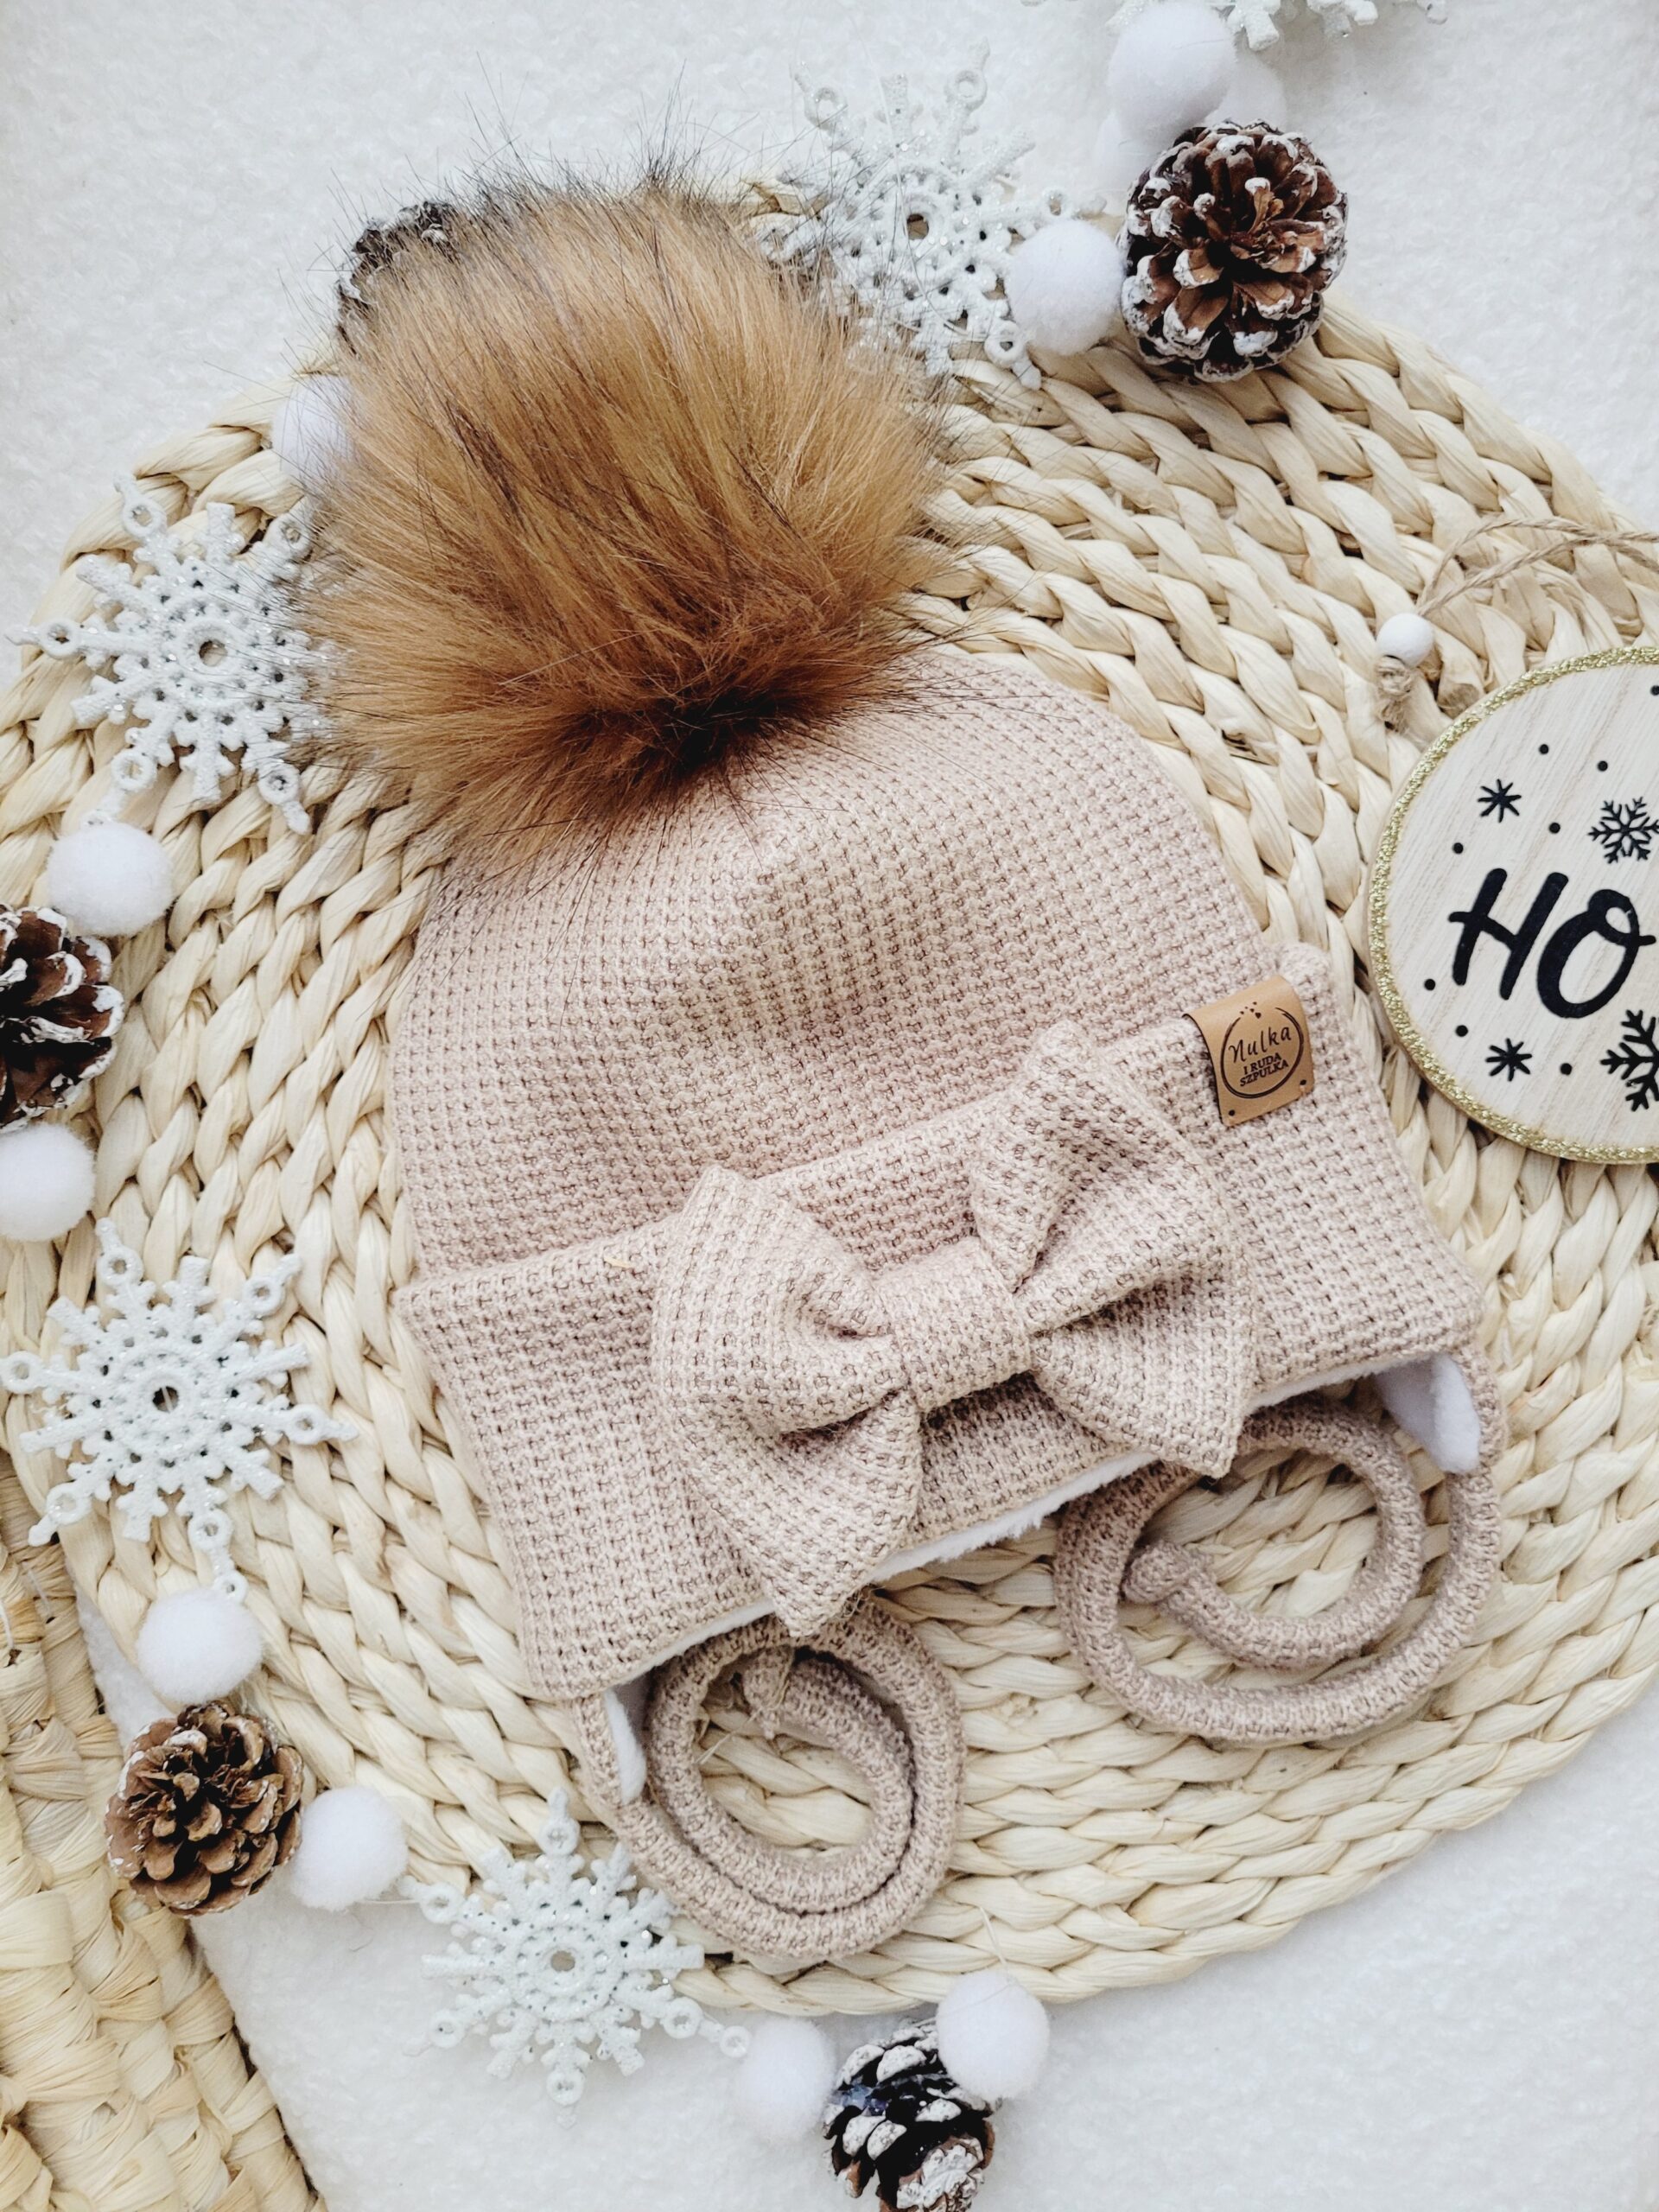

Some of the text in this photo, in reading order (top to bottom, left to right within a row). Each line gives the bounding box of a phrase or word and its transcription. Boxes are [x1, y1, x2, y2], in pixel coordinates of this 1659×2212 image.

[1448, 868, 1656, 1018] HO
[1228, 1027, 1292, 1063] Nulka
[1243, 1052, 1282, 1075] I RUDA
